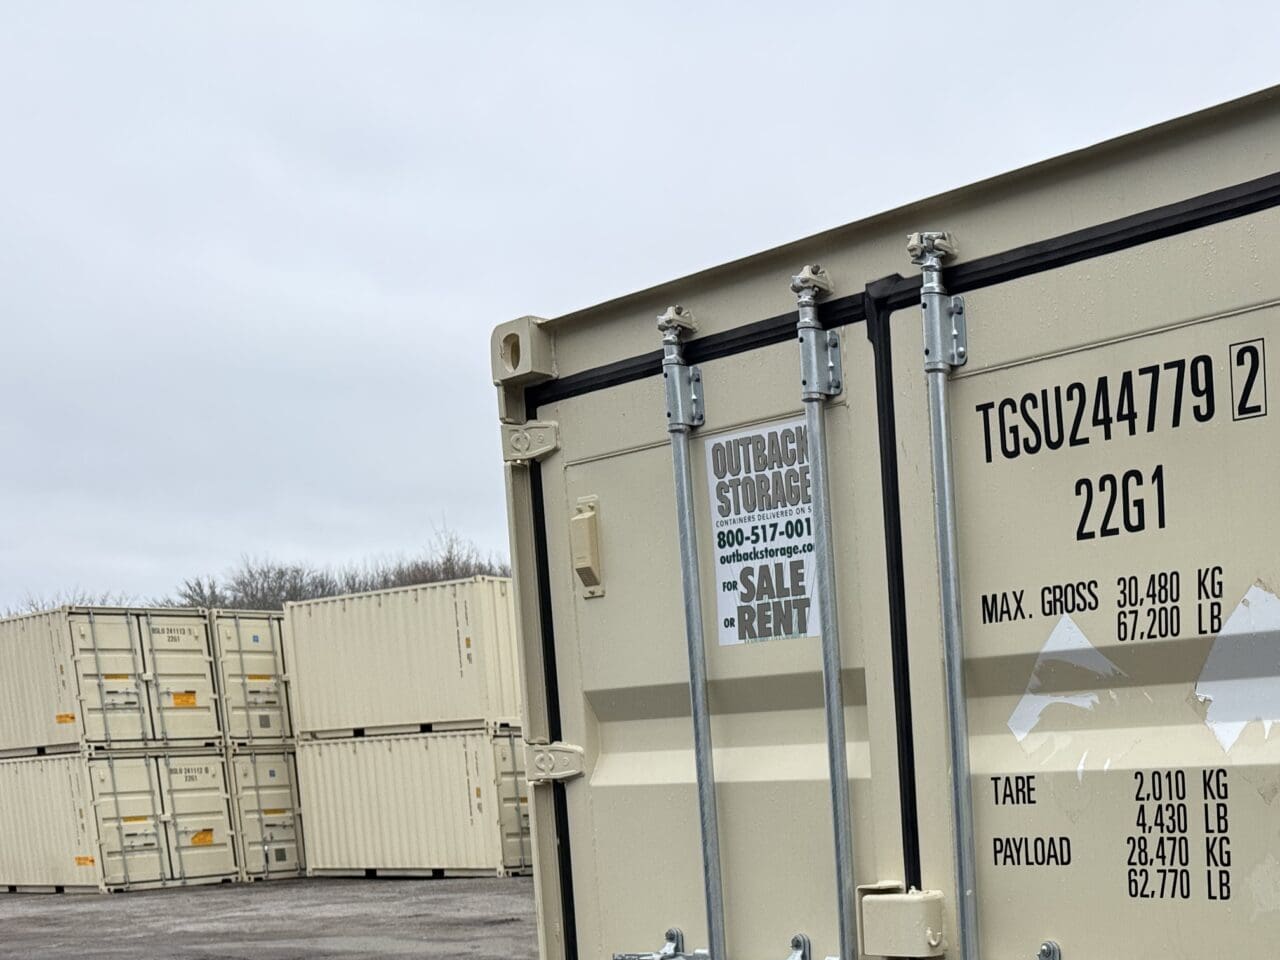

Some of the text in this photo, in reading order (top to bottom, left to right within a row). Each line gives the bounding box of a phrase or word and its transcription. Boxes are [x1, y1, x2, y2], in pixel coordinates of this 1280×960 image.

[976, 344, 1262, 464] TGSU244779 2
[712, 425, 810, 480] OUTBACK
[716, 465, 812, 518] STORAGE
[1074, 464, 1166, 541] 22G1
[716, 515, 756, 528] CONTAINERS
[758, 510, 793, 521] DELIVERED
[796, 507, 806, 515] ON
[717, 518, 812, 549] 800-517-001
[720, 542, 814, 565] outbackstorage.co
[722, 560, 806, 603] FOR SALE
[981, 566, 1223, 625] MAX. GROSS 30,480 KG
[724, 598, 811, 641] OR RENT
[1116, 601, 1222, 642] 67,200 LB
[991, 768, 1229, 806] TARE 2,010 KG
[1136, 802, 1229, 835] 4,430 LB
[993, 836, 1232, 868] PAYLOAD 28,470 KG
[1127, 868, 1231, 901] 62,770 LB
